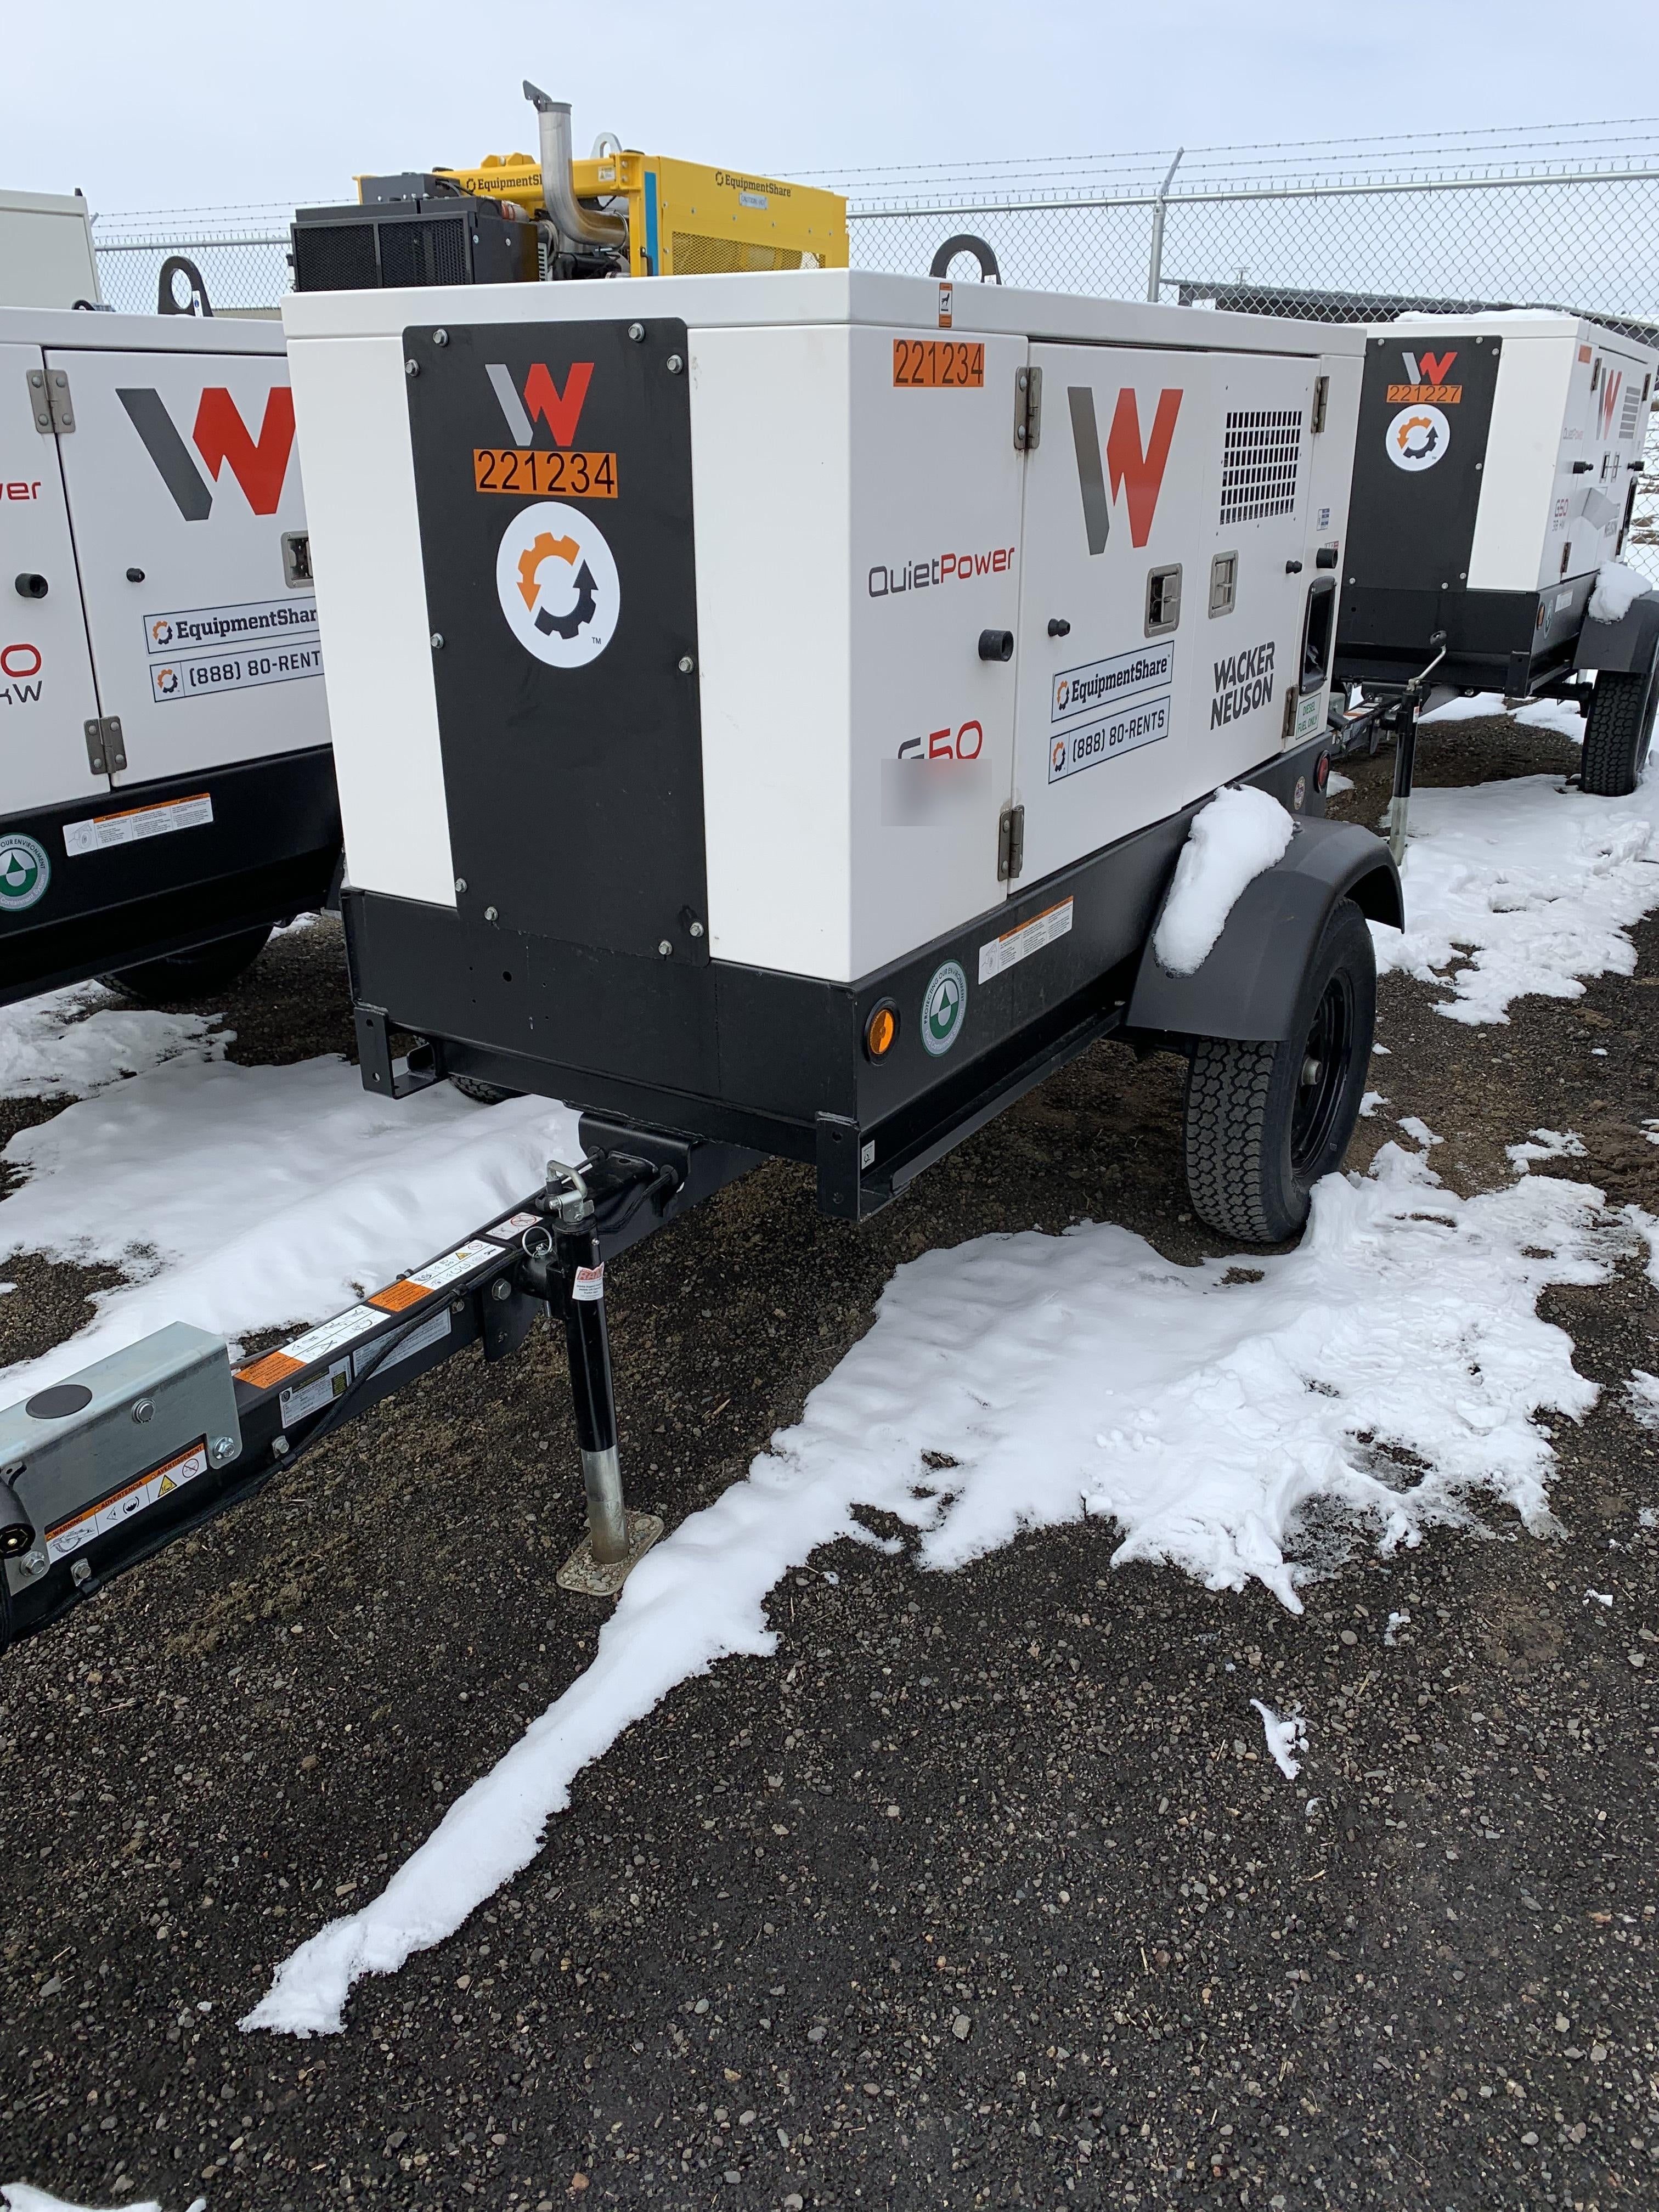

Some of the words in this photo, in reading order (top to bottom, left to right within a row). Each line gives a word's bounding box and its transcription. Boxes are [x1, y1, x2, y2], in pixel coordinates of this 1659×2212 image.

[725, 174, 791, 197] EquipmentShare
[895, 340, 983, 385] 221234
[1389, 386, 1460, 402] 221227
[477, 451, 614, 494] 221234
[0, 481, 41, 500] er
[869, 547, 1014, 597] QuietPower
[189, 662, 240, 687] (888)
[1071, 658, 1167, 703] EquipmentShare
[1214, 641, 1275, 693] WACKER
[1210, 673, 1273, 730] NEUSON
[1302, 701, 1316, 716] DIESEL
[1073, 729, 1105, 763] (888)
[1109, 709, 1164, 746] 80-RENTS
[1298, 720, 1307, 733] FUEL
[1, 839, 13, 848] OUR
[14, 839, 46, 868] ENVIRONMENT
[924, 978, 938, 1024] PROTECTING
[939, 968, 947, 979] OUR
[947, 967, 964, 1001] ENVIRONMENT
[156, 1446, 203, 1476] AVERTISSEMENT
[101, 1481, 143, 1509] ADVERTENCIA
[53, 1516, 83, 1536] WARNING
